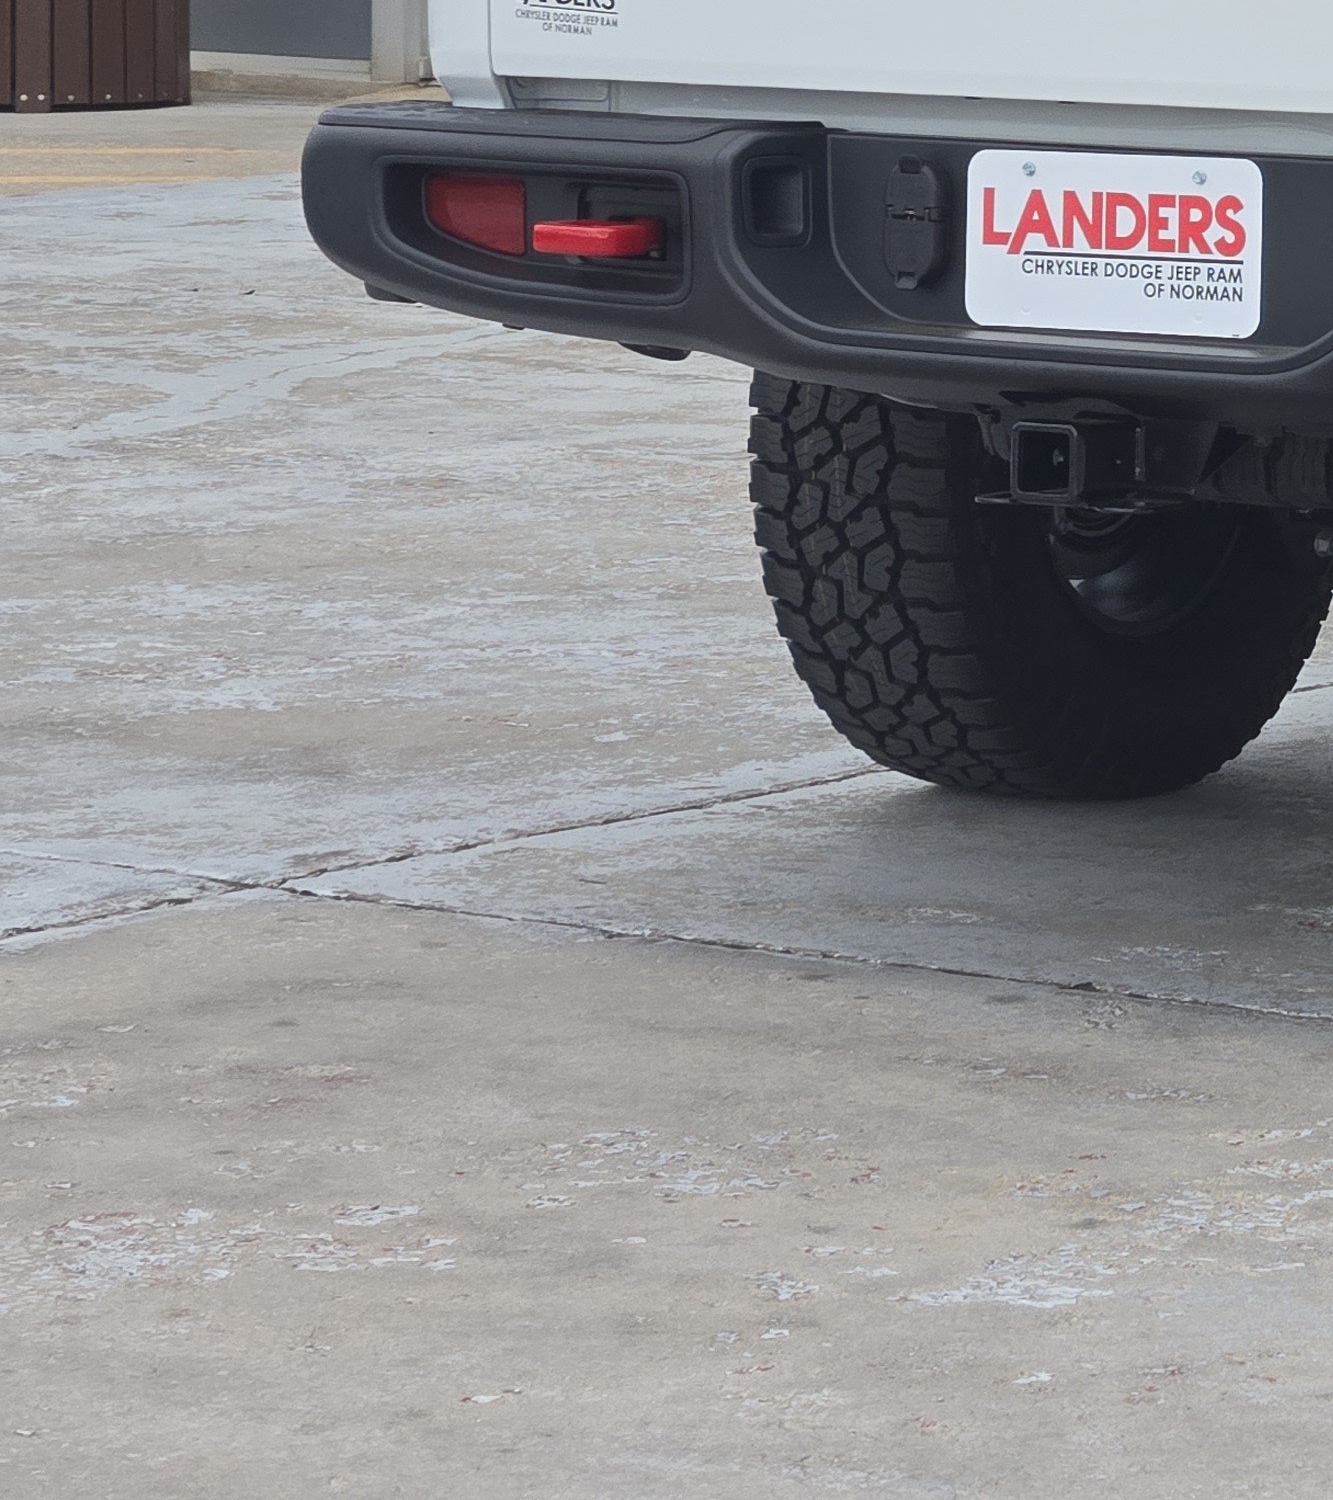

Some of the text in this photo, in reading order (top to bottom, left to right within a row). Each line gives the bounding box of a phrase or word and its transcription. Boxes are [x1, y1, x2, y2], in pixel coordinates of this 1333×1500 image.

[515, 8, 618, 27] CHRYSLER DODGE JEEP RAM
[542, 21, 592, 35] OF NORMAN
[981, 186, 1247, 258] LANDERS
[1021, 258, 1243, 284] CHRYSLER DODGE JEEP RAM
[1143, 282, 1243, 302] OF NORMAN
